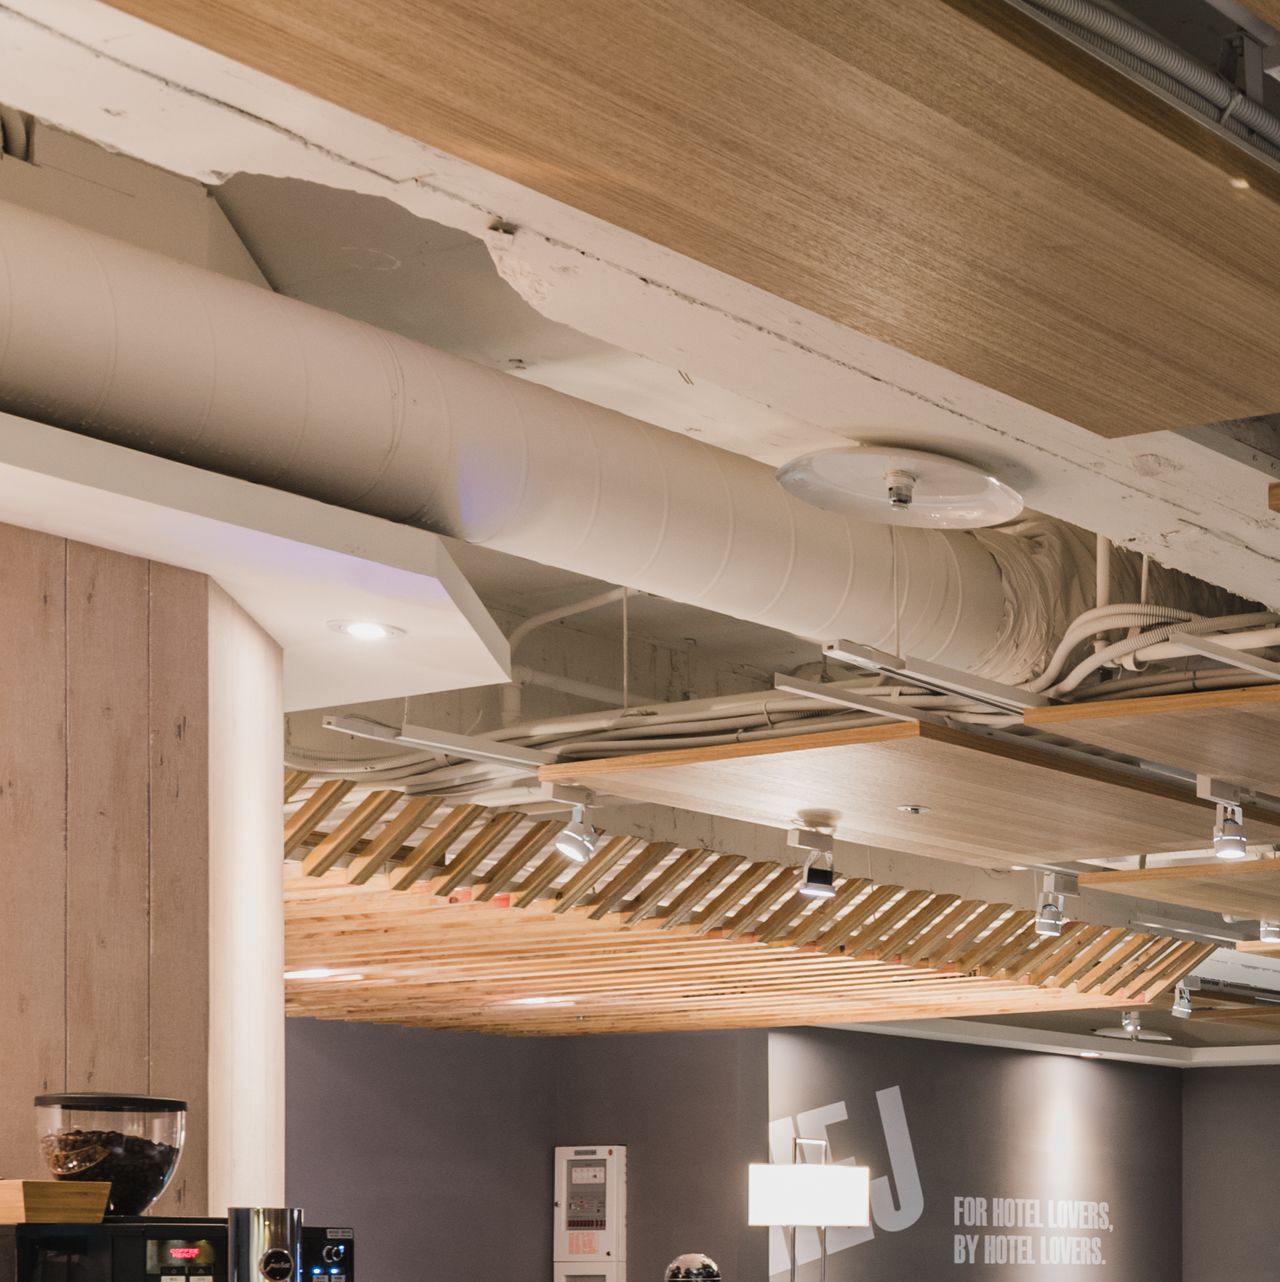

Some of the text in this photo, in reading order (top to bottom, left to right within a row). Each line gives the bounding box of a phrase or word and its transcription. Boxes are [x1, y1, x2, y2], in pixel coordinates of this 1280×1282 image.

[953, 1196, 1114, 1233] FOR HOTEL LOVERS,
[953, 1234, 1107, 1265] BY HOTEL LOVERS.
